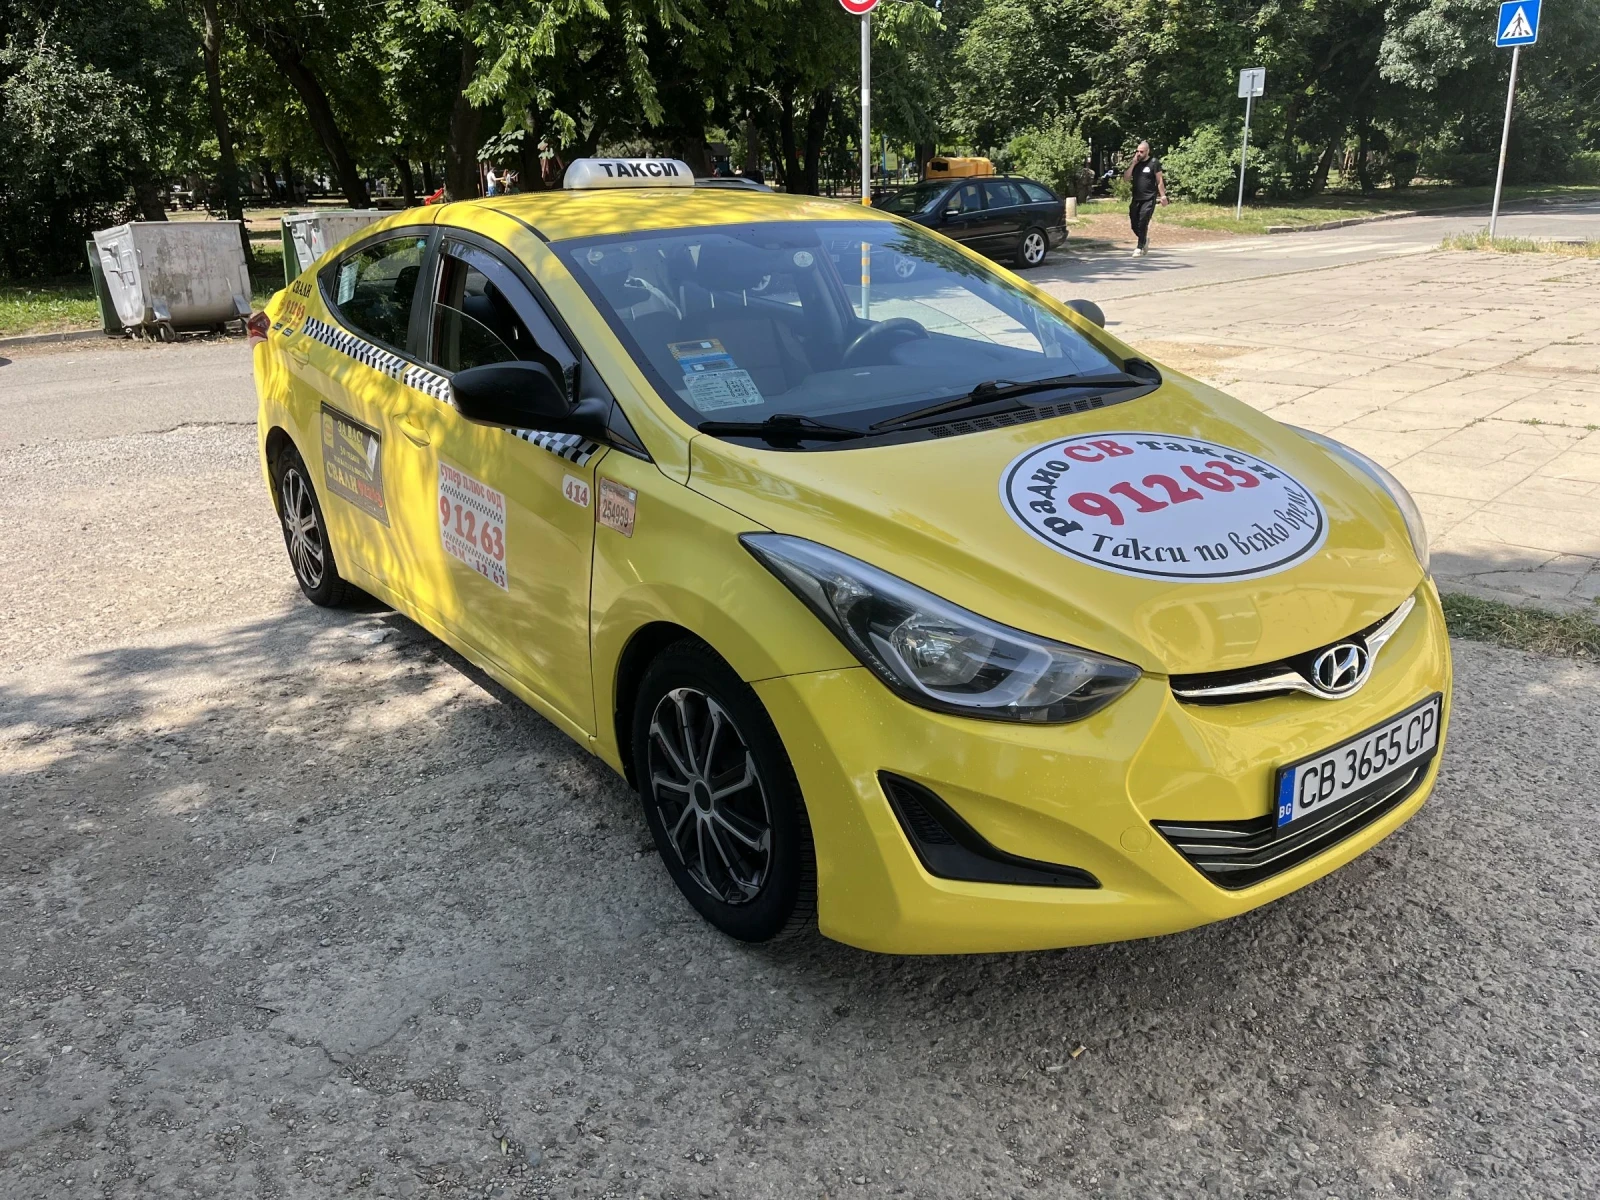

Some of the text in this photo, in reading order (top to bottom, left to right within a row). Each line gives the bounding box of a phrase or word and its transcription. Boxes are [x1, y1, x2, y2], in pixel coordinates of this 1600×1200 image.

[598, 163, 679, 177] ТАКСИ
[440, 463, 461, 489] супер
[463, 475, 485, 499] плюс
[566, 481, 588, 506] 414
[1026, 440, 1280, 537] радио СВ такси
[1068, 460, 1260, 526] 91263
[602, 499, 629, 528] 254959
[1092, 486, 1315, 563] Такси по всяко време
[445, 541, 466, 563] GSM
[1341, 724, 1403, 789] 3655
[1279, 803, 1292, 819] BG
